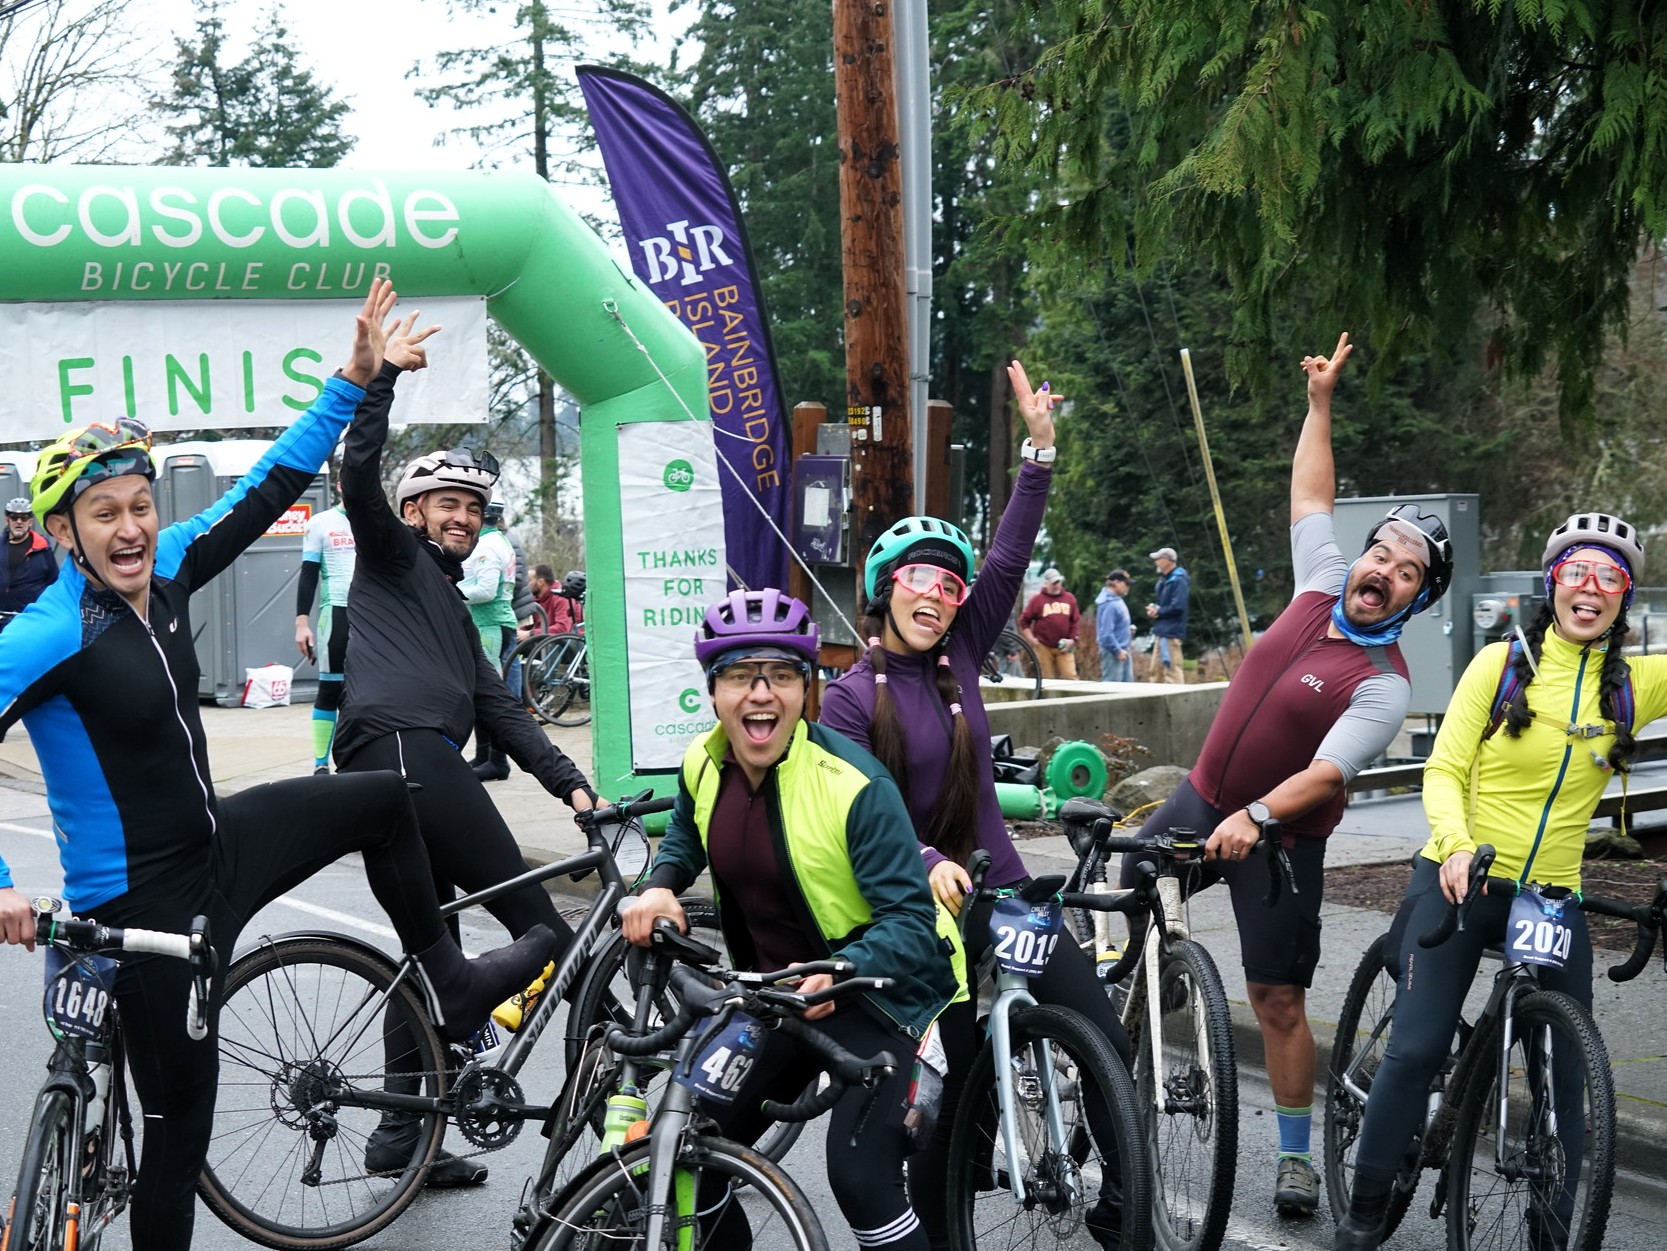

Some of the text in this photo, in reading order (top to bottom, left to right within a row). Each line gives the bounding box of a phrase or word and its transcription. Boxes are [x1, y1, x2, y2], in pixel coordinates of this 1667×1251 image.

[11, 178, 460, 249] cascade
[80, 262, 264, 291] BICYCLE
[58, 347, 325, 424] FINIS
[713, 285, 780, 492] BAINBRIDGE
[333, 537, 355, 547] BRA
[637, 548, 717, 569] THANKS
[664, 578, 704, 597] FOR
[643, 606, 706, 627] RIDIN
[1300, 673, 1325, 693] GVL
[994, 925, 1059, 966] 2019
[1512, 919, 1572, 960] 2020
[55, 977, 109, 1028] 1648
[701, 1046, 754, 1092] 462
